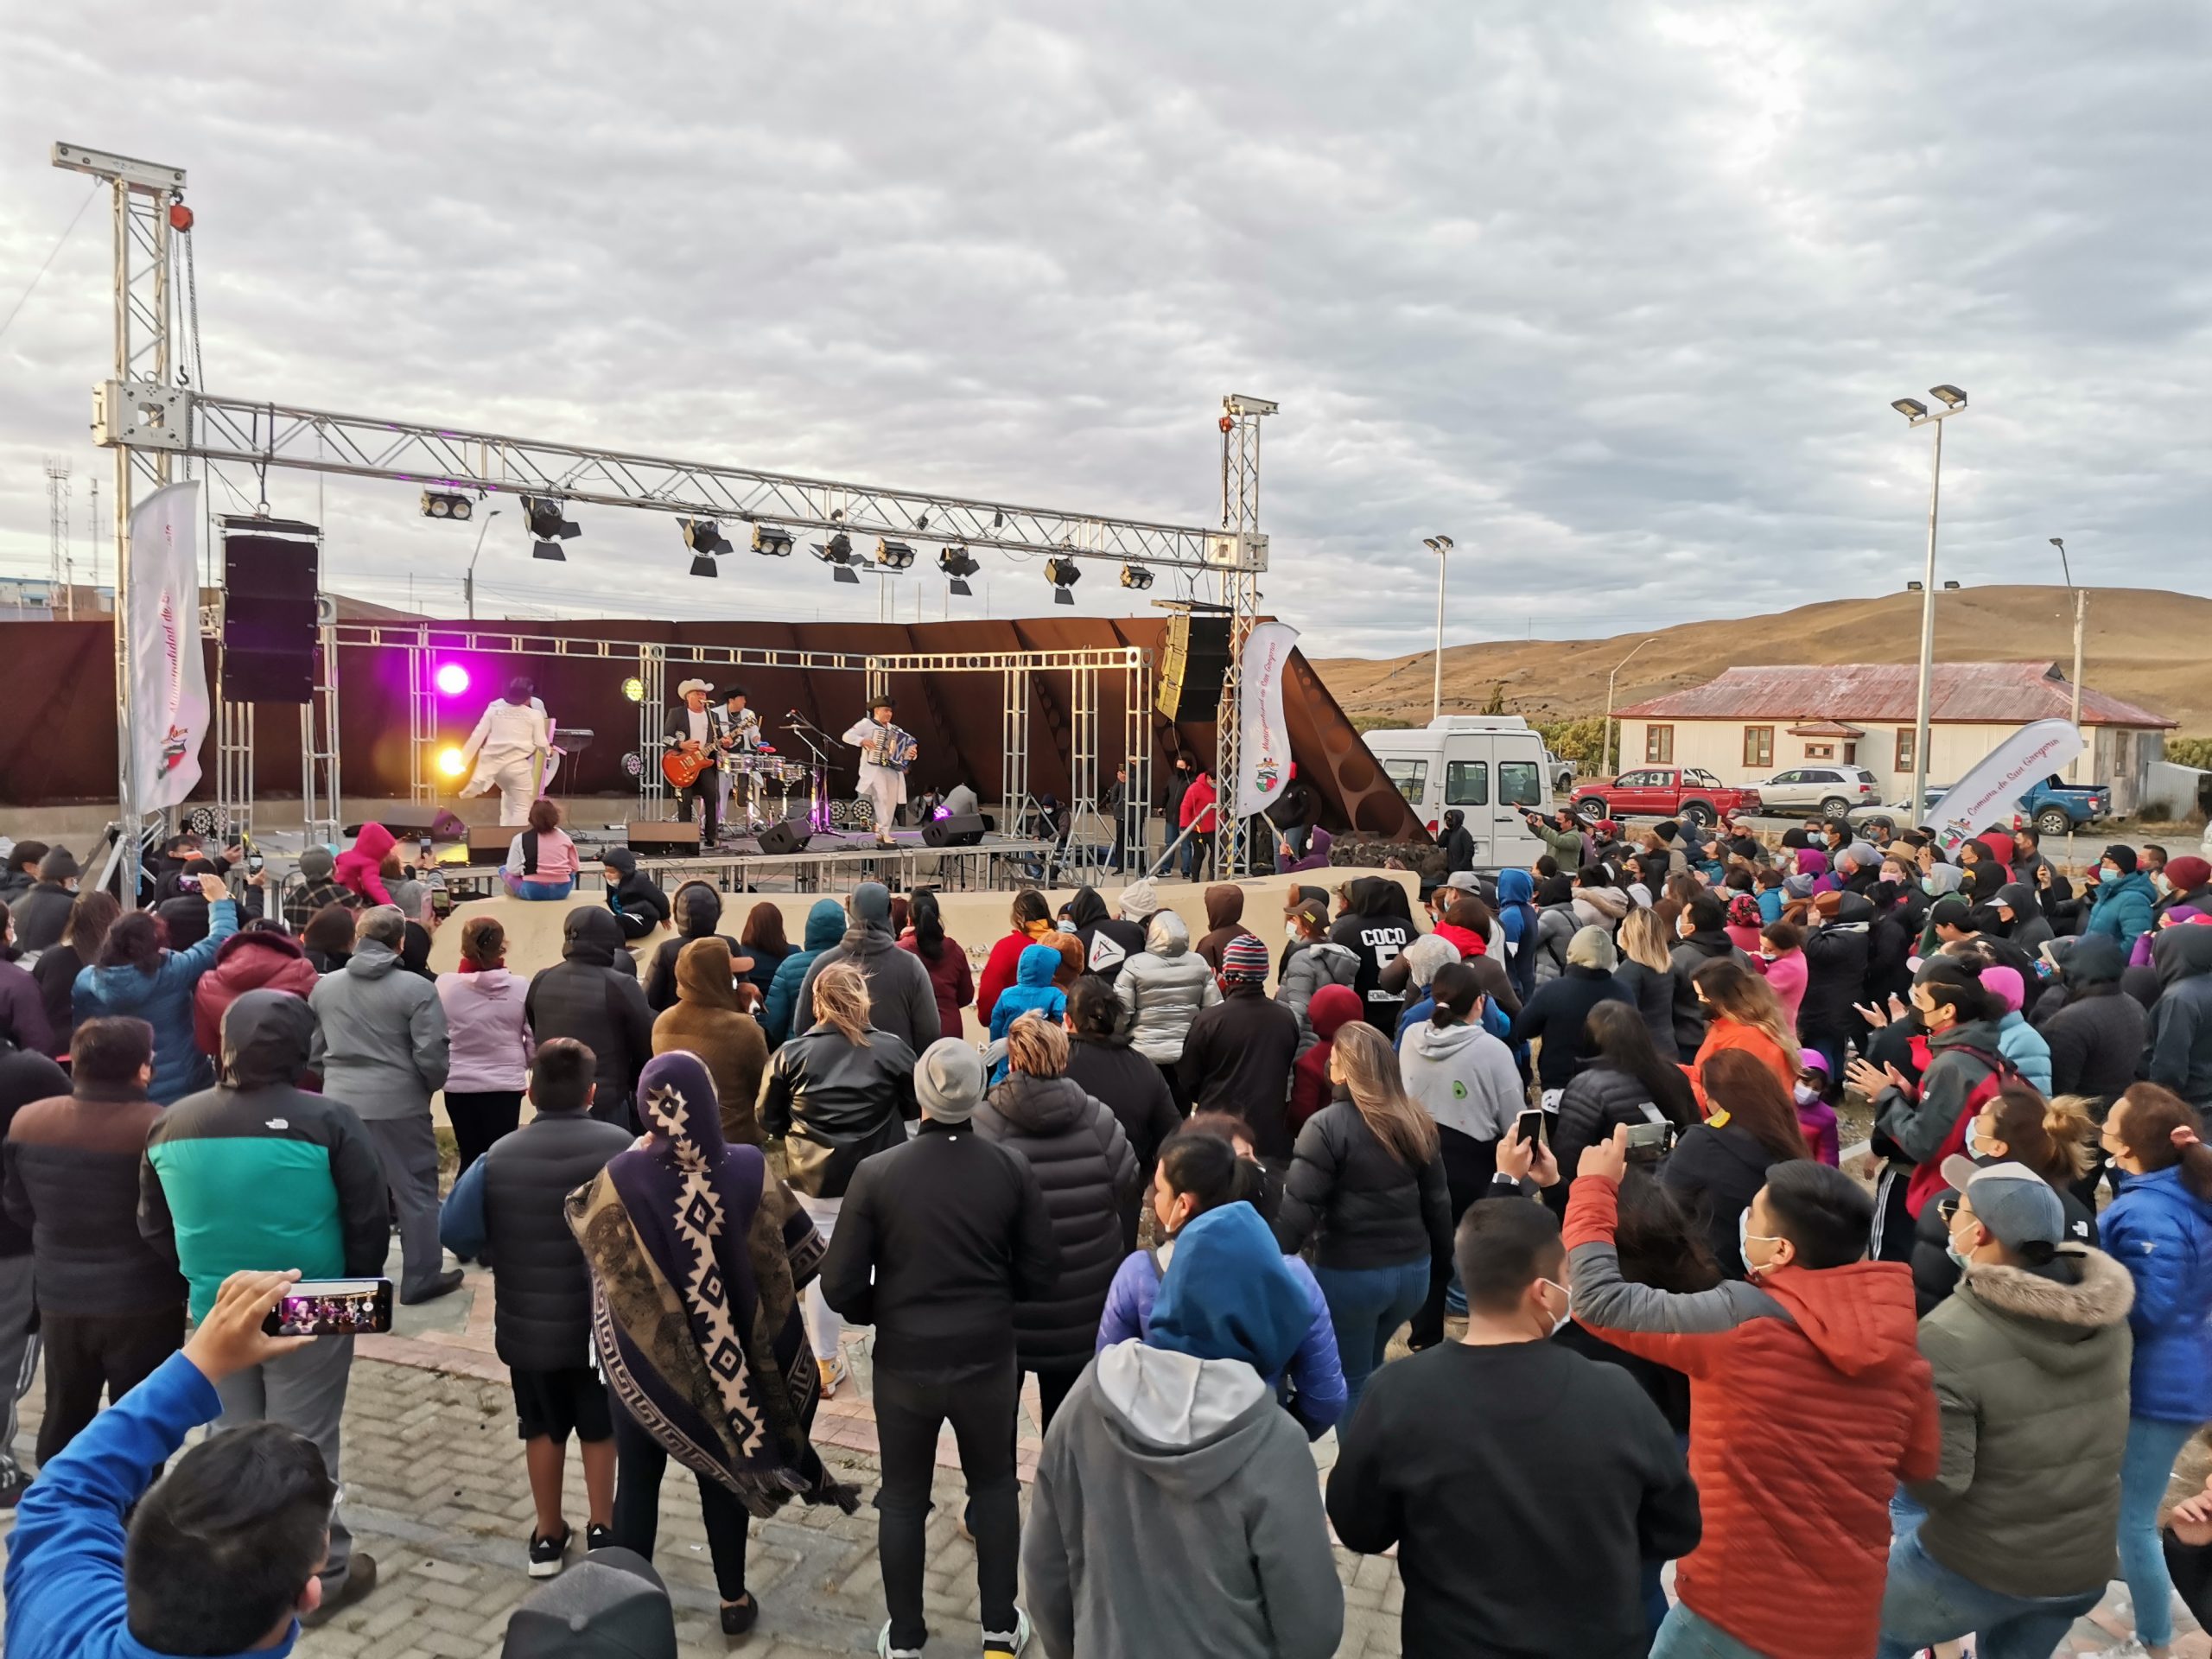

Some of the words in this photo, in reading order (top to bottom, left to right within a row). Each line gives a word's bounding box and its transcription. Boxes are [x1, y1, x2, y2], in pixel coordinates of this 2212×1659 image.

[1263, 642, 1276, 672] Gregorio
[1261, 673, 1270, 687] San
[1258, 697, 1270, 752] Municipalidad
[1967, 789, 1999, 817] Comuna
[1996, 780, 2010, 791] de
[2005, 766, 2025, 782] San
[2022, 738, 2061, 767] Gregorio
[1360, 927, 1407, 947] COCO
